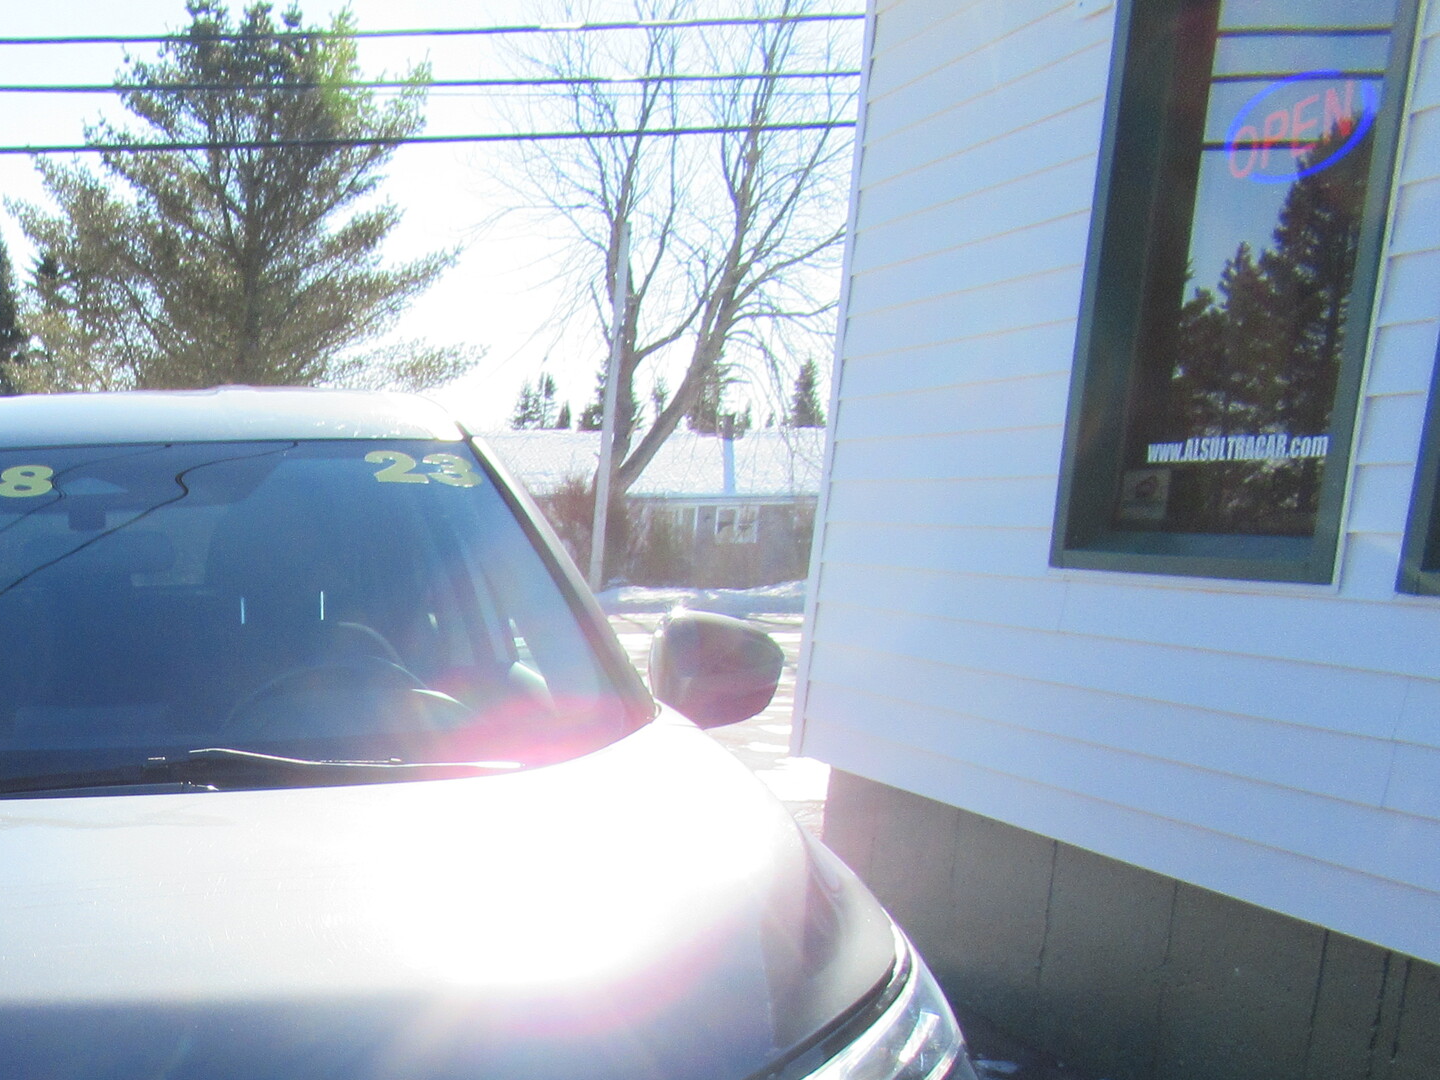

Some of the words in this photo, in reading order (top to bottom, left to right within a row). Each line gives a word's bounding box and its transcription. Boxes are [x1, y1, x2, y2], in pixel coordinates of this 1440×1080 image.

[1229, 79, 1356, 179] OPEN
[1147, 433, 1329, 462] www.ALSULTRACAR.com
[365, 450, 482, 487] 23
